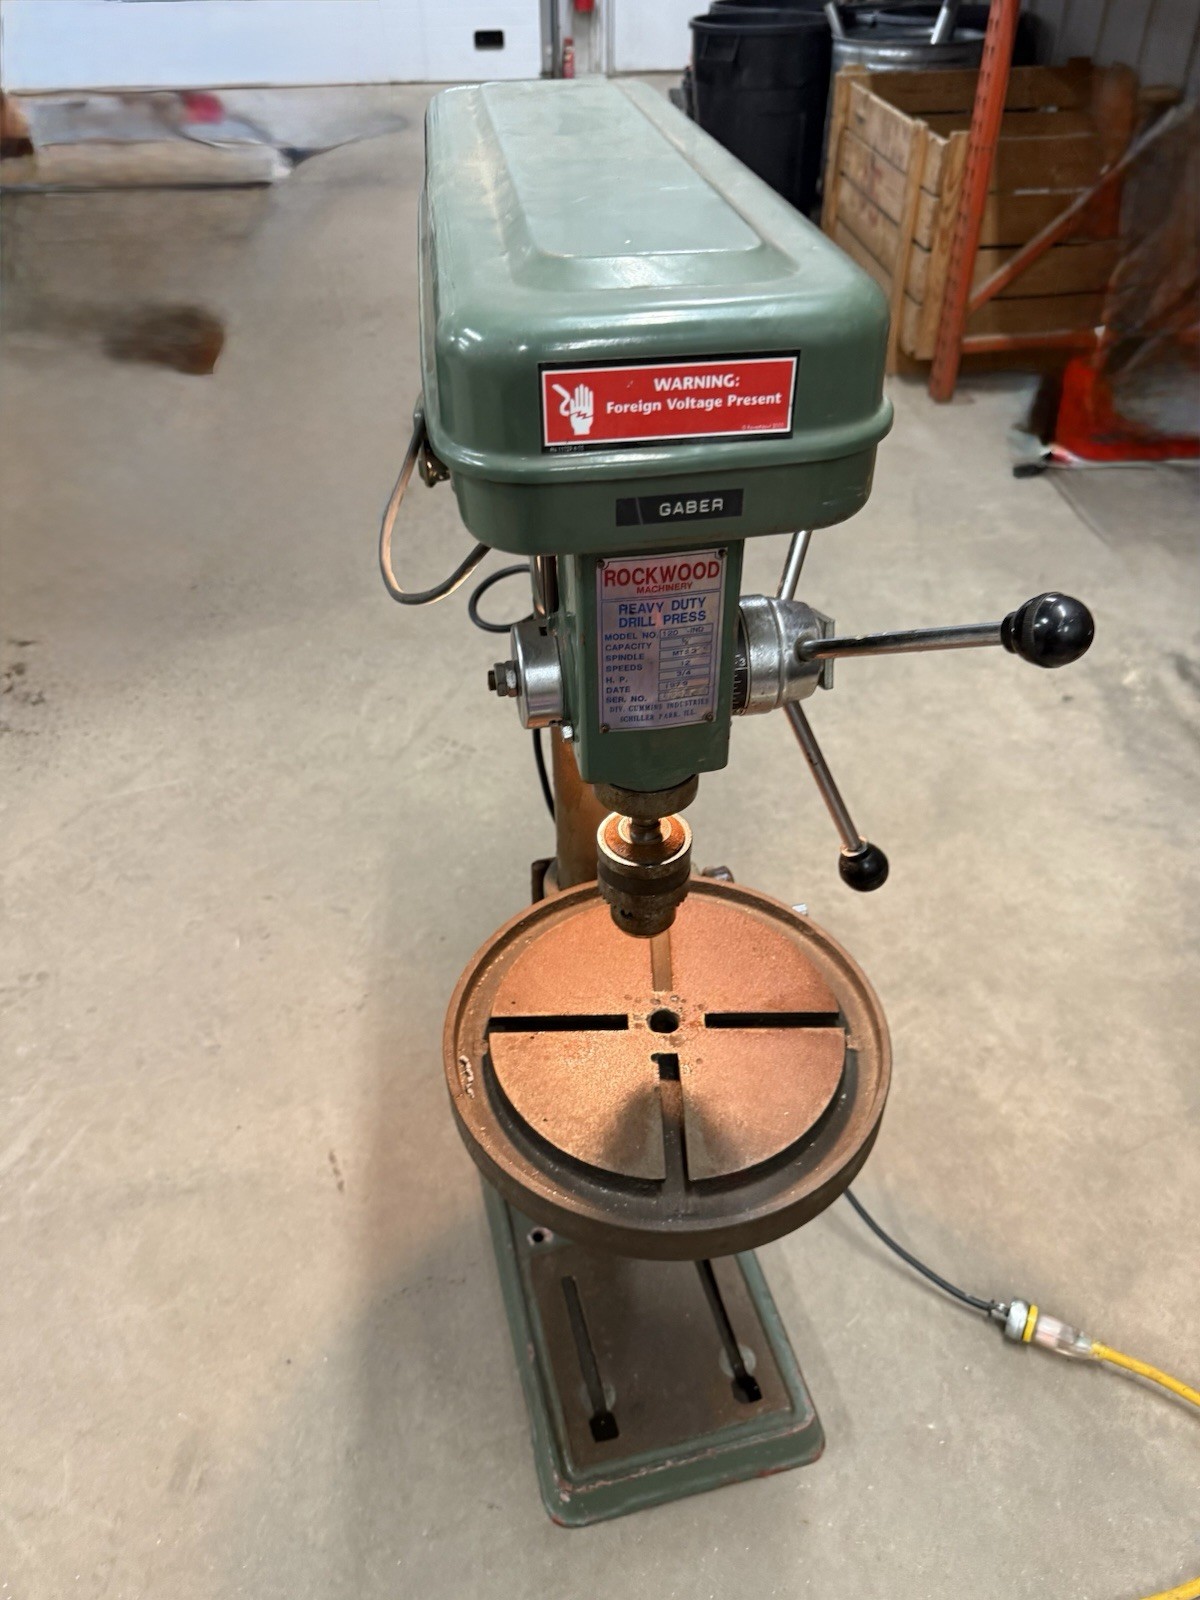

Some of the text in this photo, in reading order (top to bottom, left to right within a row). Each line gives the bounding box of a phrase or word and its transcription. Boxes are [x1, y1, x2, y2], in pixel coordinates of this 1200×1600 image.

[654, 373, 740, 392] WARNING:
[606, 392, 782, 415] Foreign Voltage Present
[659, 498, 724, 517] GABER
[604, 561, 720, 588] ROCKWOOD
[636, 582, 693, 594] MACHINERY
[618, 597, 706, 616] HEAVY DUTY
[618, 611, 706, 628] DRILL PRESS
[604, 632, 638, 641] MODEL
[605, 642, 652, 651] CAPACITY
[605, 653, 645, 662] SPINDLE
[605, 663, 643, 672] SPEEDS
[606, 686, 631, 694] DATE
[630, 695, 647, 703] NO.
